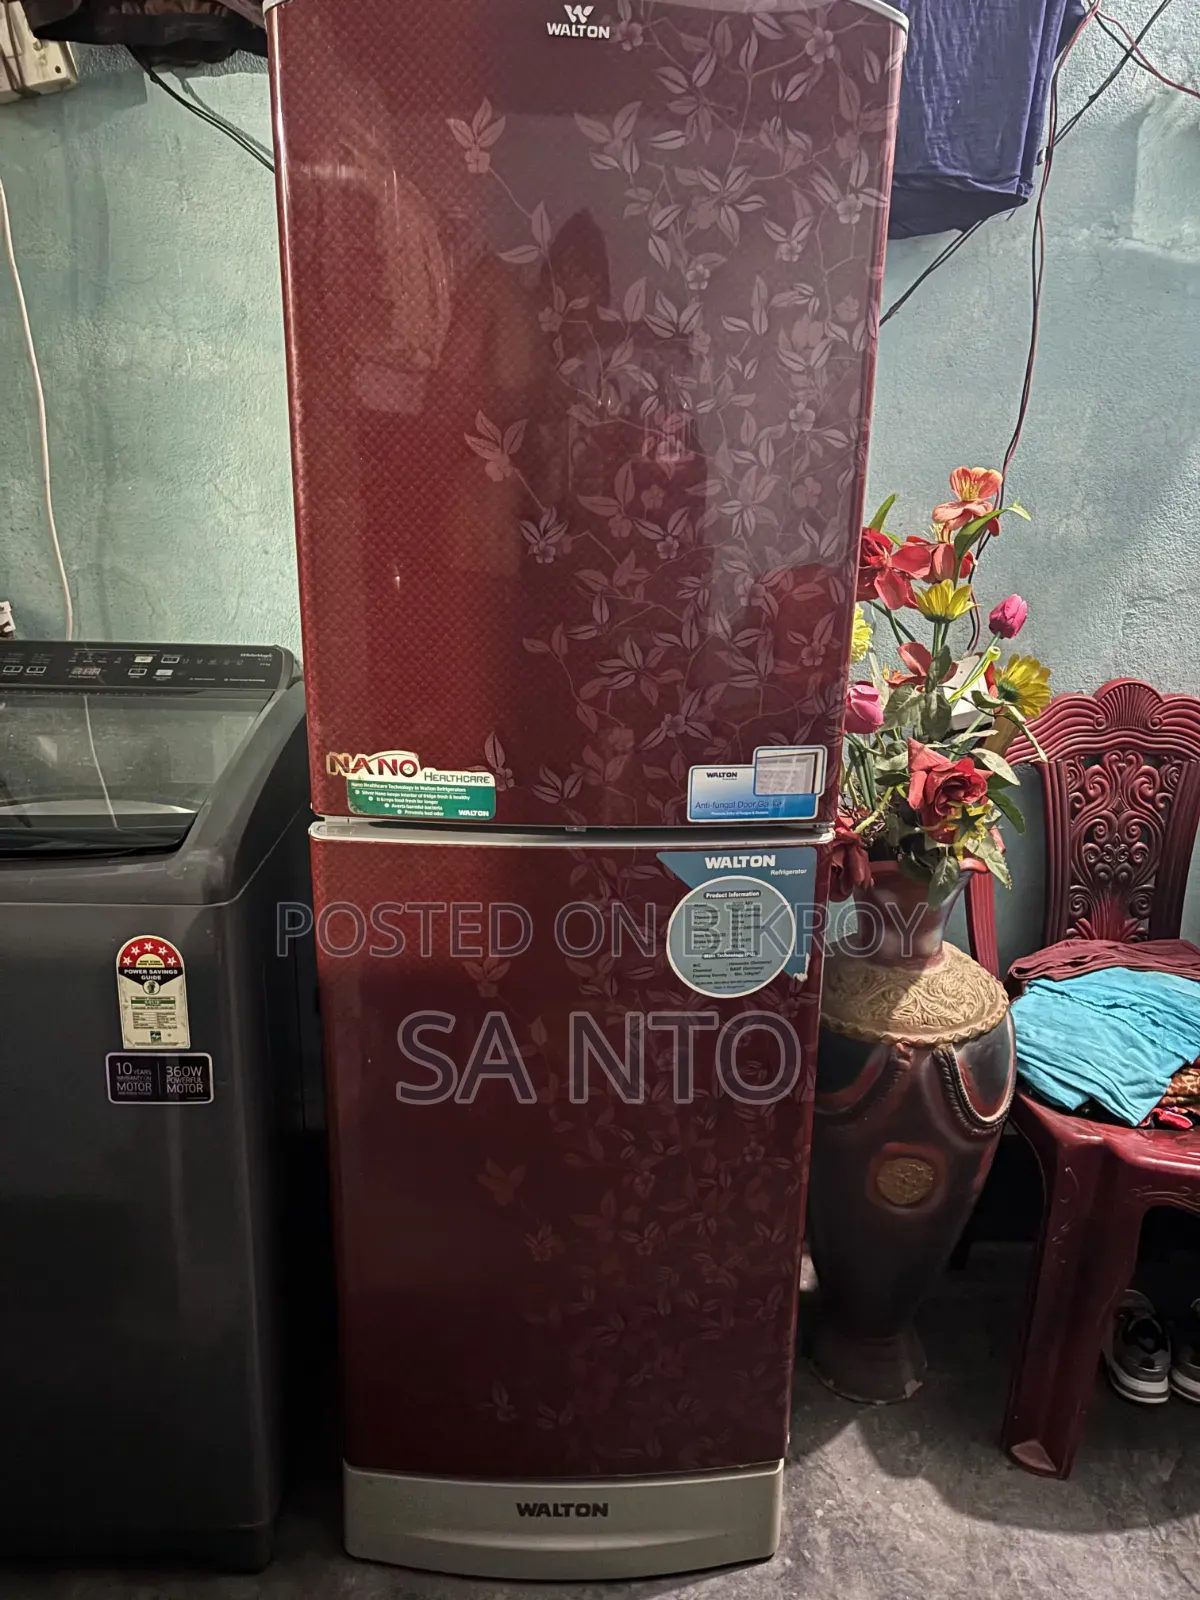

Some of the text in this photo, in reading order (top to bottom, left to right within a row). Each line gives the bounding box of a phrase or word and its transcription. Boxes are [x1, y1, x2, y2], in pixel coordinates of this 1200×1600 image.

[546, 22, 610, 39] WALTON
[330, 755, 418, 778] NANO
[695, 801, 736, 810] Anti-fungal
[737, 800, 755, 809] Door
[458, 809, 490, 817] WALTON
[704, 854, 776, 869] WALTON
[770, 868, 807, 876] Refrigerator
[116, 1062, 133, 1075] 10
[165, 1066, 203, 1077] 360W
[166, 1076, 203, 1084] POWERFUL
[116, 1082, 152, 1091] MOTOR
[166, 1083, 204, 1093] MOTOR
[516, 1502, 609, 1517] WALTON
